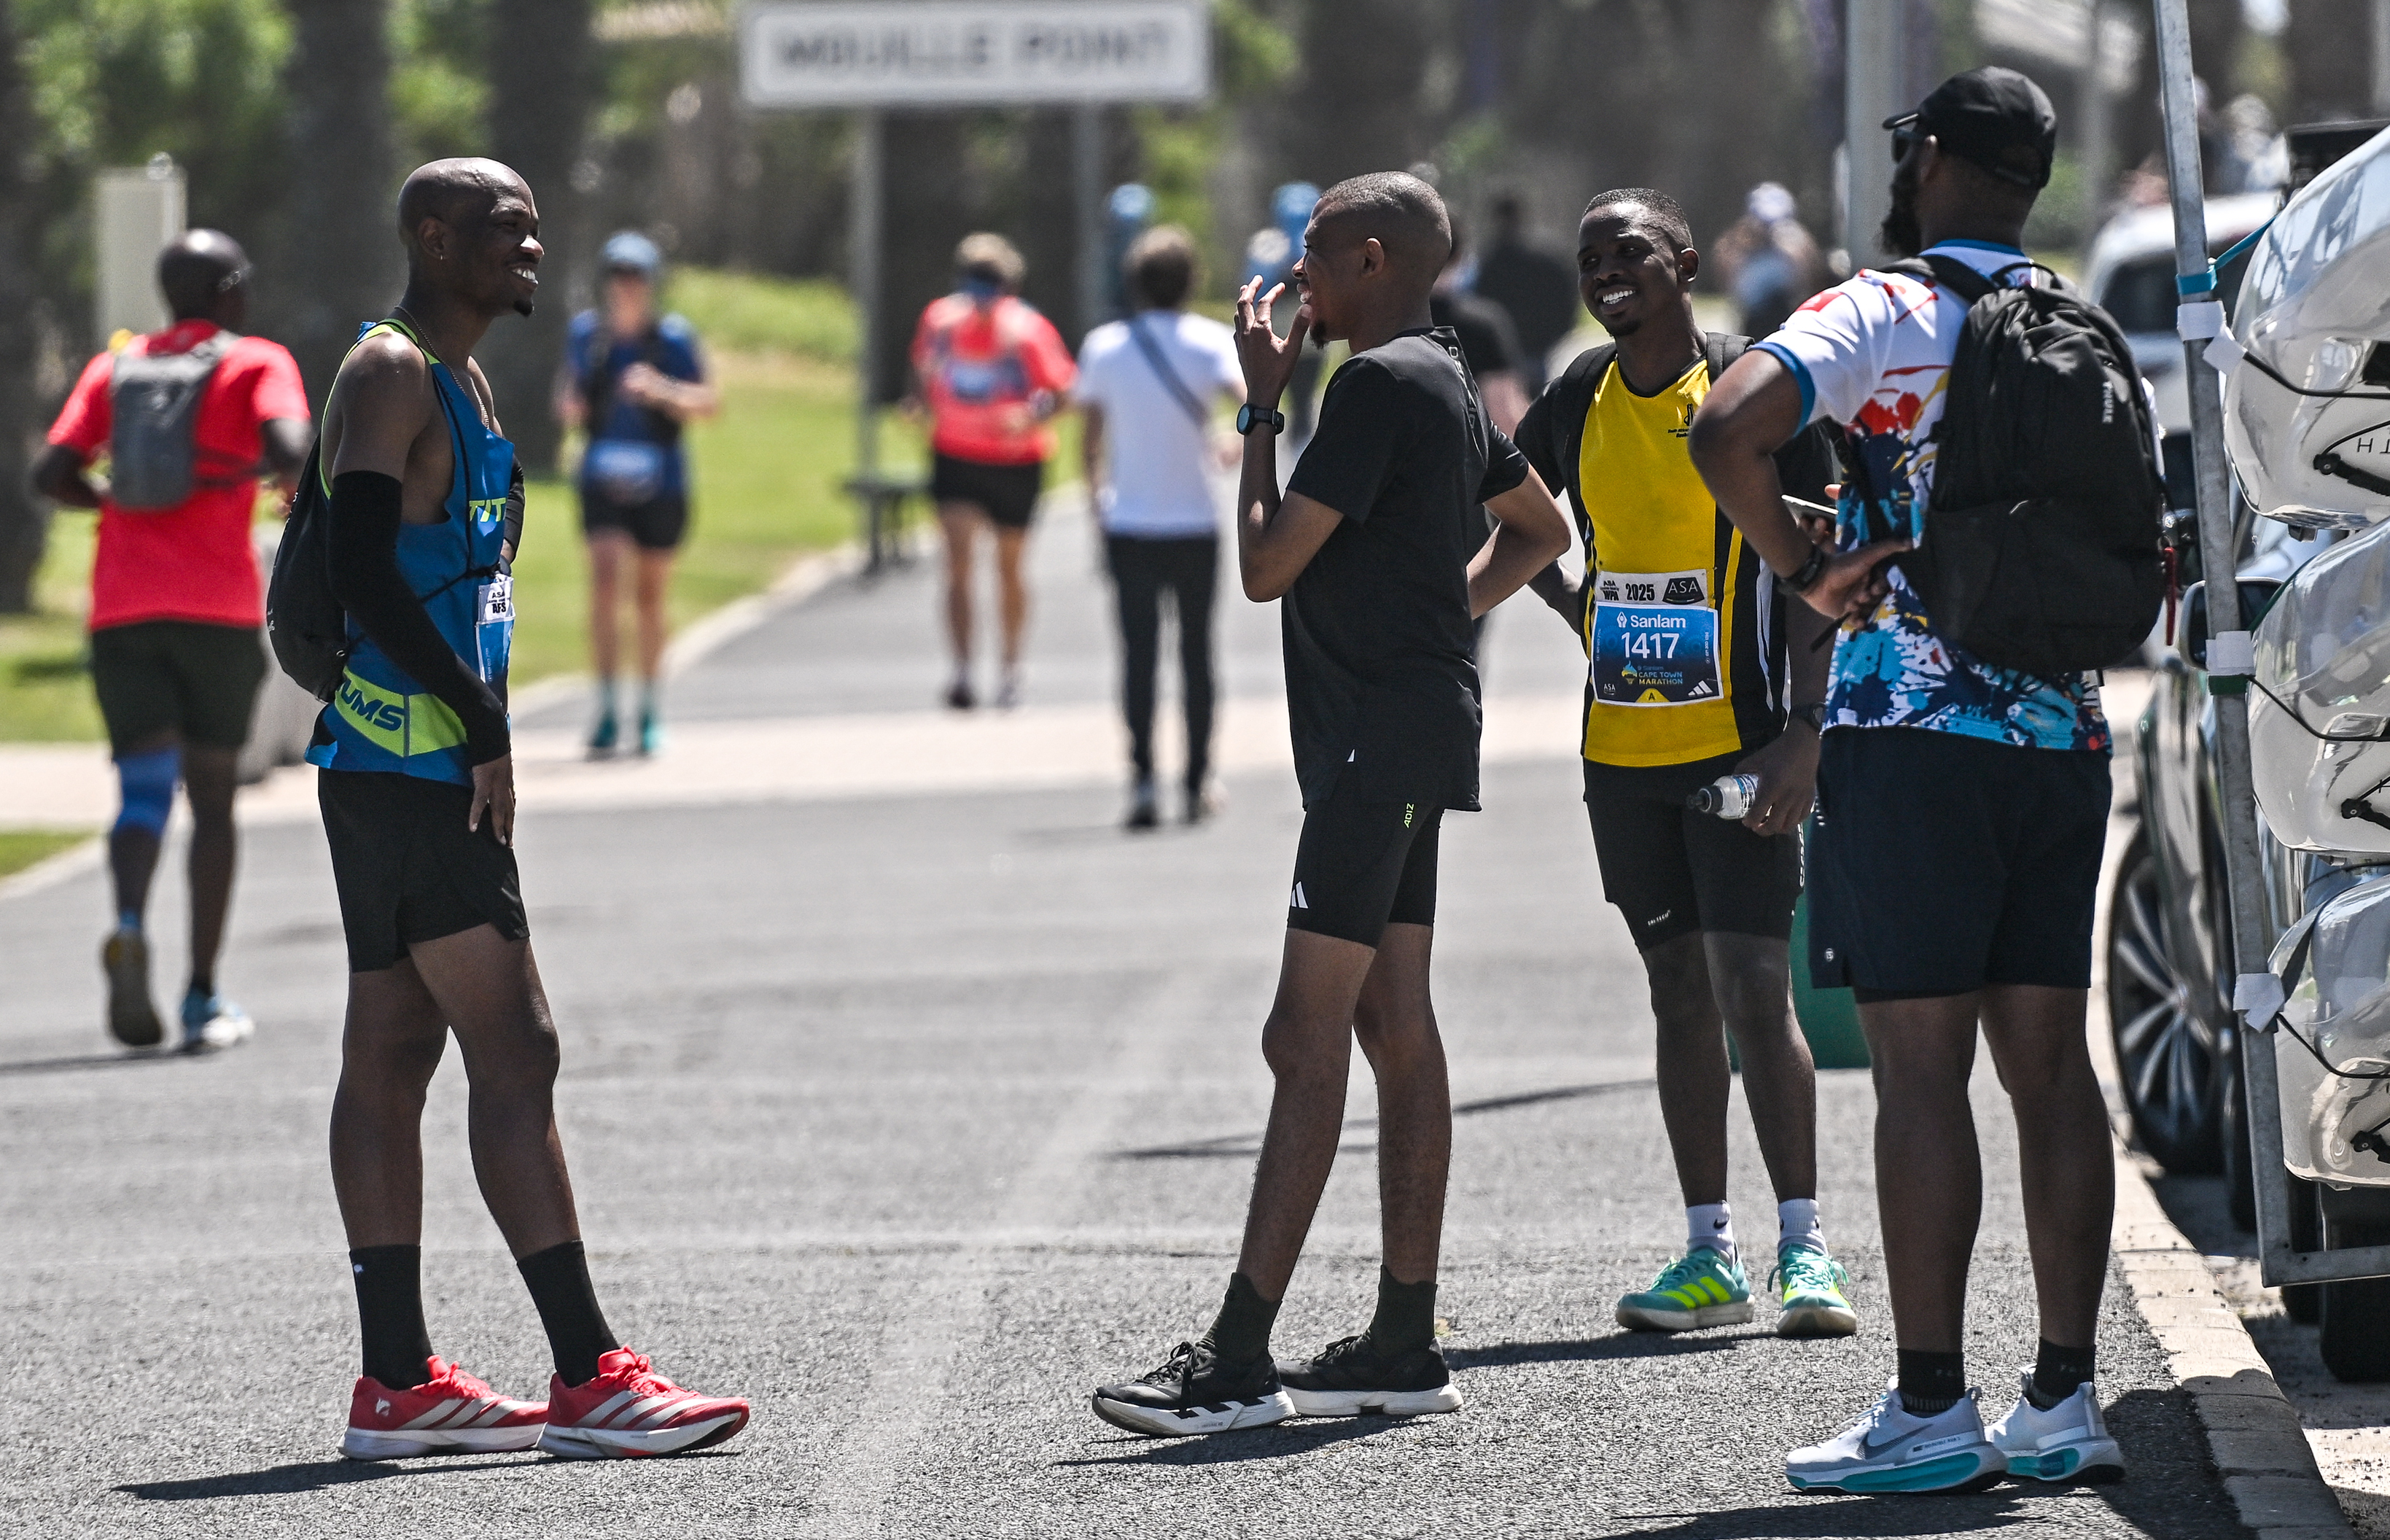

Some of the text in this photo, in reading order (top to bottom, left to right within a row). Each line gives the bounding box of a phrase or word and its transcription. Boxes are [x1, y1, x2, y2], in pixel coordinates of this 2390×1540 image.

[1019, 20, 1171, 66] POINT
[1625, 583, 1655, 601] 2025
[1668, 580, 1698, 594] ASA
[492, 602, 506, 613] AFS
[1630, 615, 1686, 628] Sanlam
[1622, 632, 1680, 658] 1417
[1648, 692, 1655, 701] A
[337, 679, 405, 731] UMS
